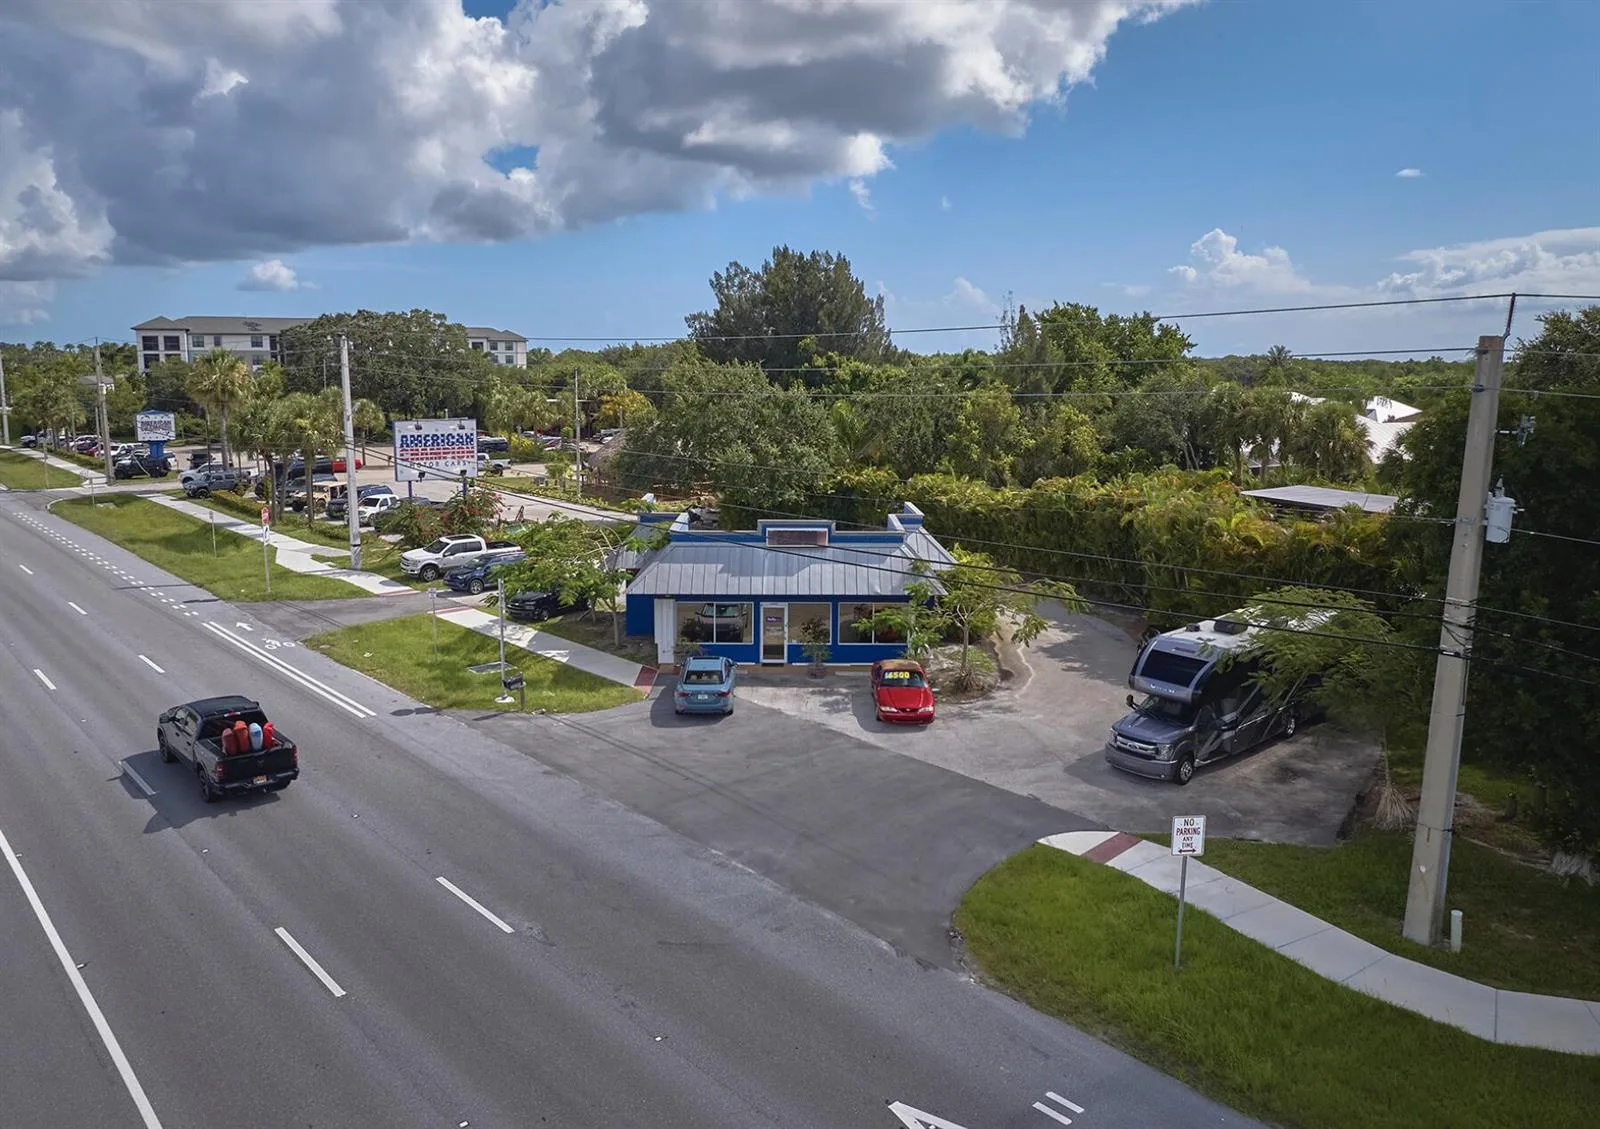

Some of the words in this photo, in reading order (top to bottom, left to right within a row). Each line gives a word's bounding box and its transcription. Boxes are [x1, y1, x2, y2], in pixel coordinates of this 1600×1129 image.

[400, 433, 475, 448] AMERICAN
[1183, 818, 1195, 827] NO
[1176, 827, 1201, 836] PARKING
